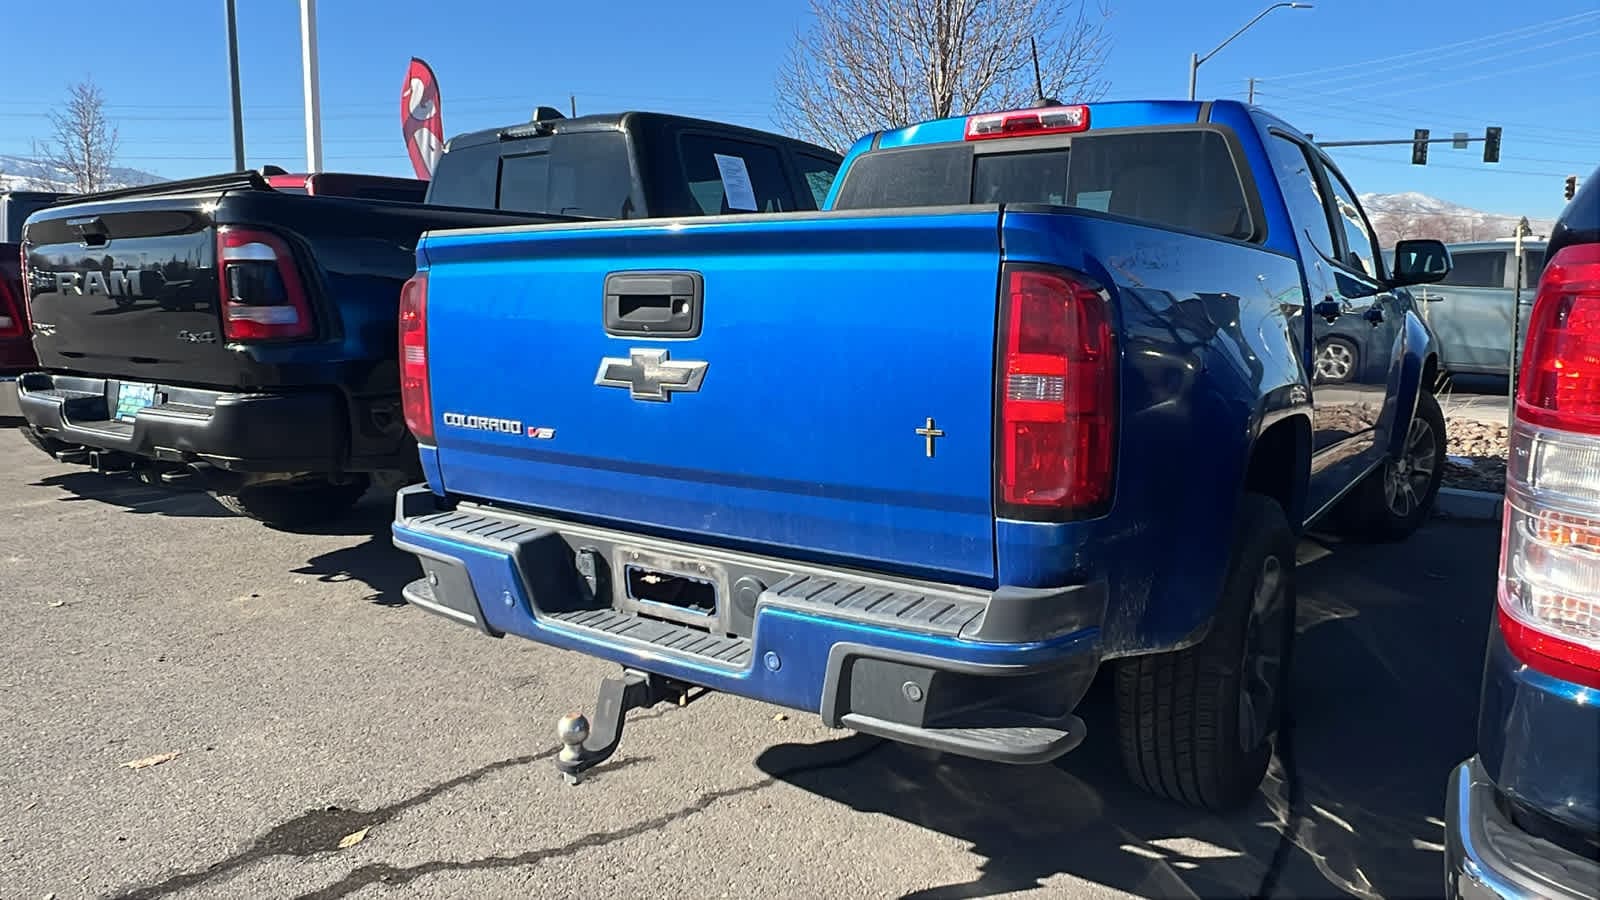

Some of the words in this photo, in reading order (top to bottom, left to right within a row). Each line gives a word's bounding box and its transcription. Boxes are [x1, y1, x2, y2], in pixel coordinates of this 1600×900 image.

[56, 270, 142, 296] RAM
[177, 329, 217, 344] 4x4
[443, 412, 523, 434] COLORADO
[527, 427, 556, 439] V6
